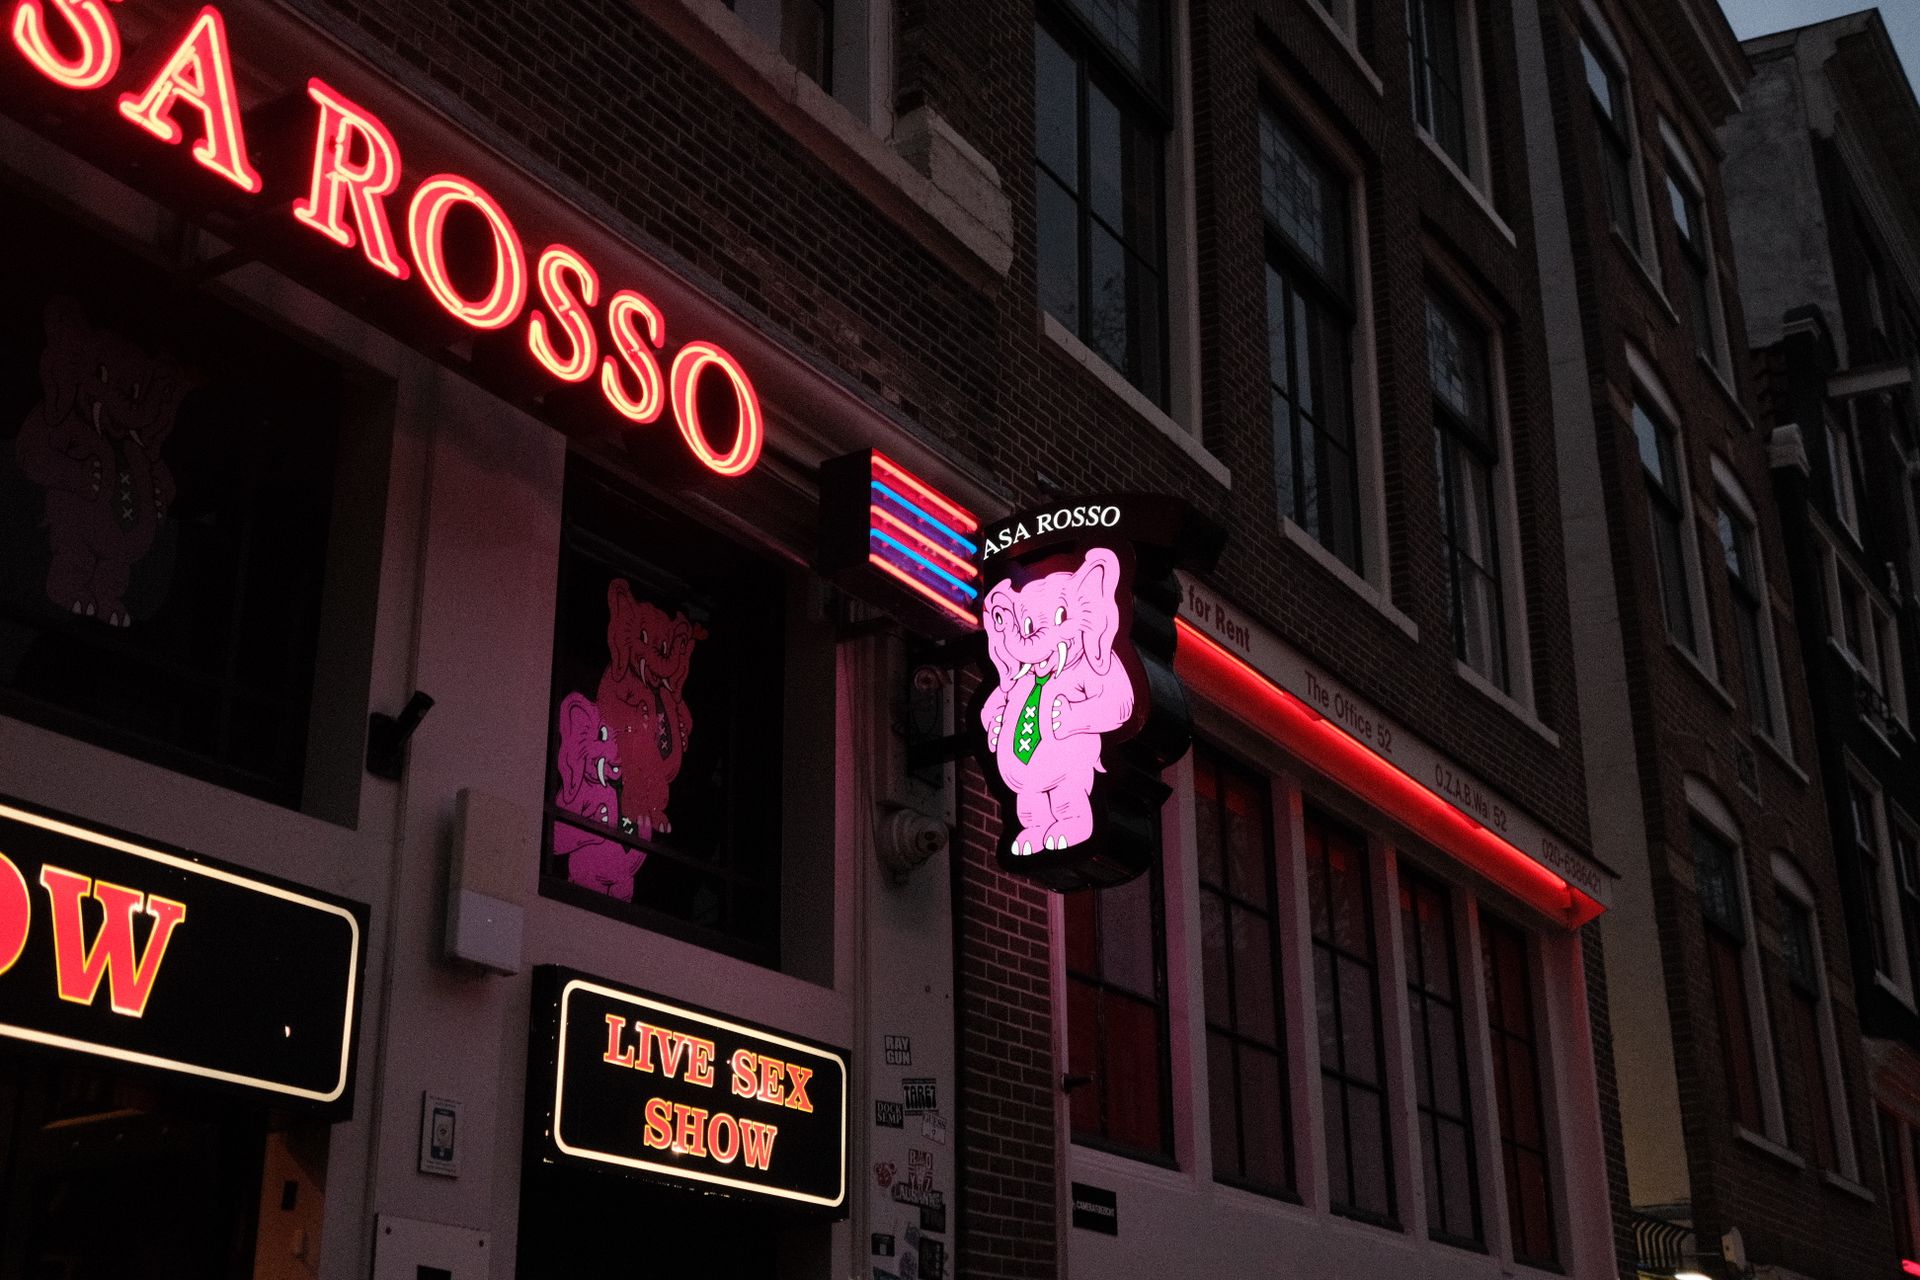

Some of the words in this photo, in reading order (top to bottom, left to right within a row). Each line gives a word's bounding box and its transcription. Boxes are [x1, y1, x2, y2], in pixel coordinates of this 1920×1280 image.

[293, 77, 764, 477] ROSSO
[1036, 505, 1121, 535] ROSSO
[1188, 584, 1211, 622] for
[1215, 603, 1250, 652] Rent
[1304, 670, 1330, 711] The
[1334, 694, 1373, 740] Office
[1377, 728, 1393, 754] 52
[1493, 805, 1507, 832] 52
[603, 1014, 715, 1087] LIVE
[732, 1048, 813, 1113] SEX
[885, 1036, 910, 1050] RAY
[886, 1050, 911, 1065] GUN
[644, 1097, 777, 1171] SHOW
